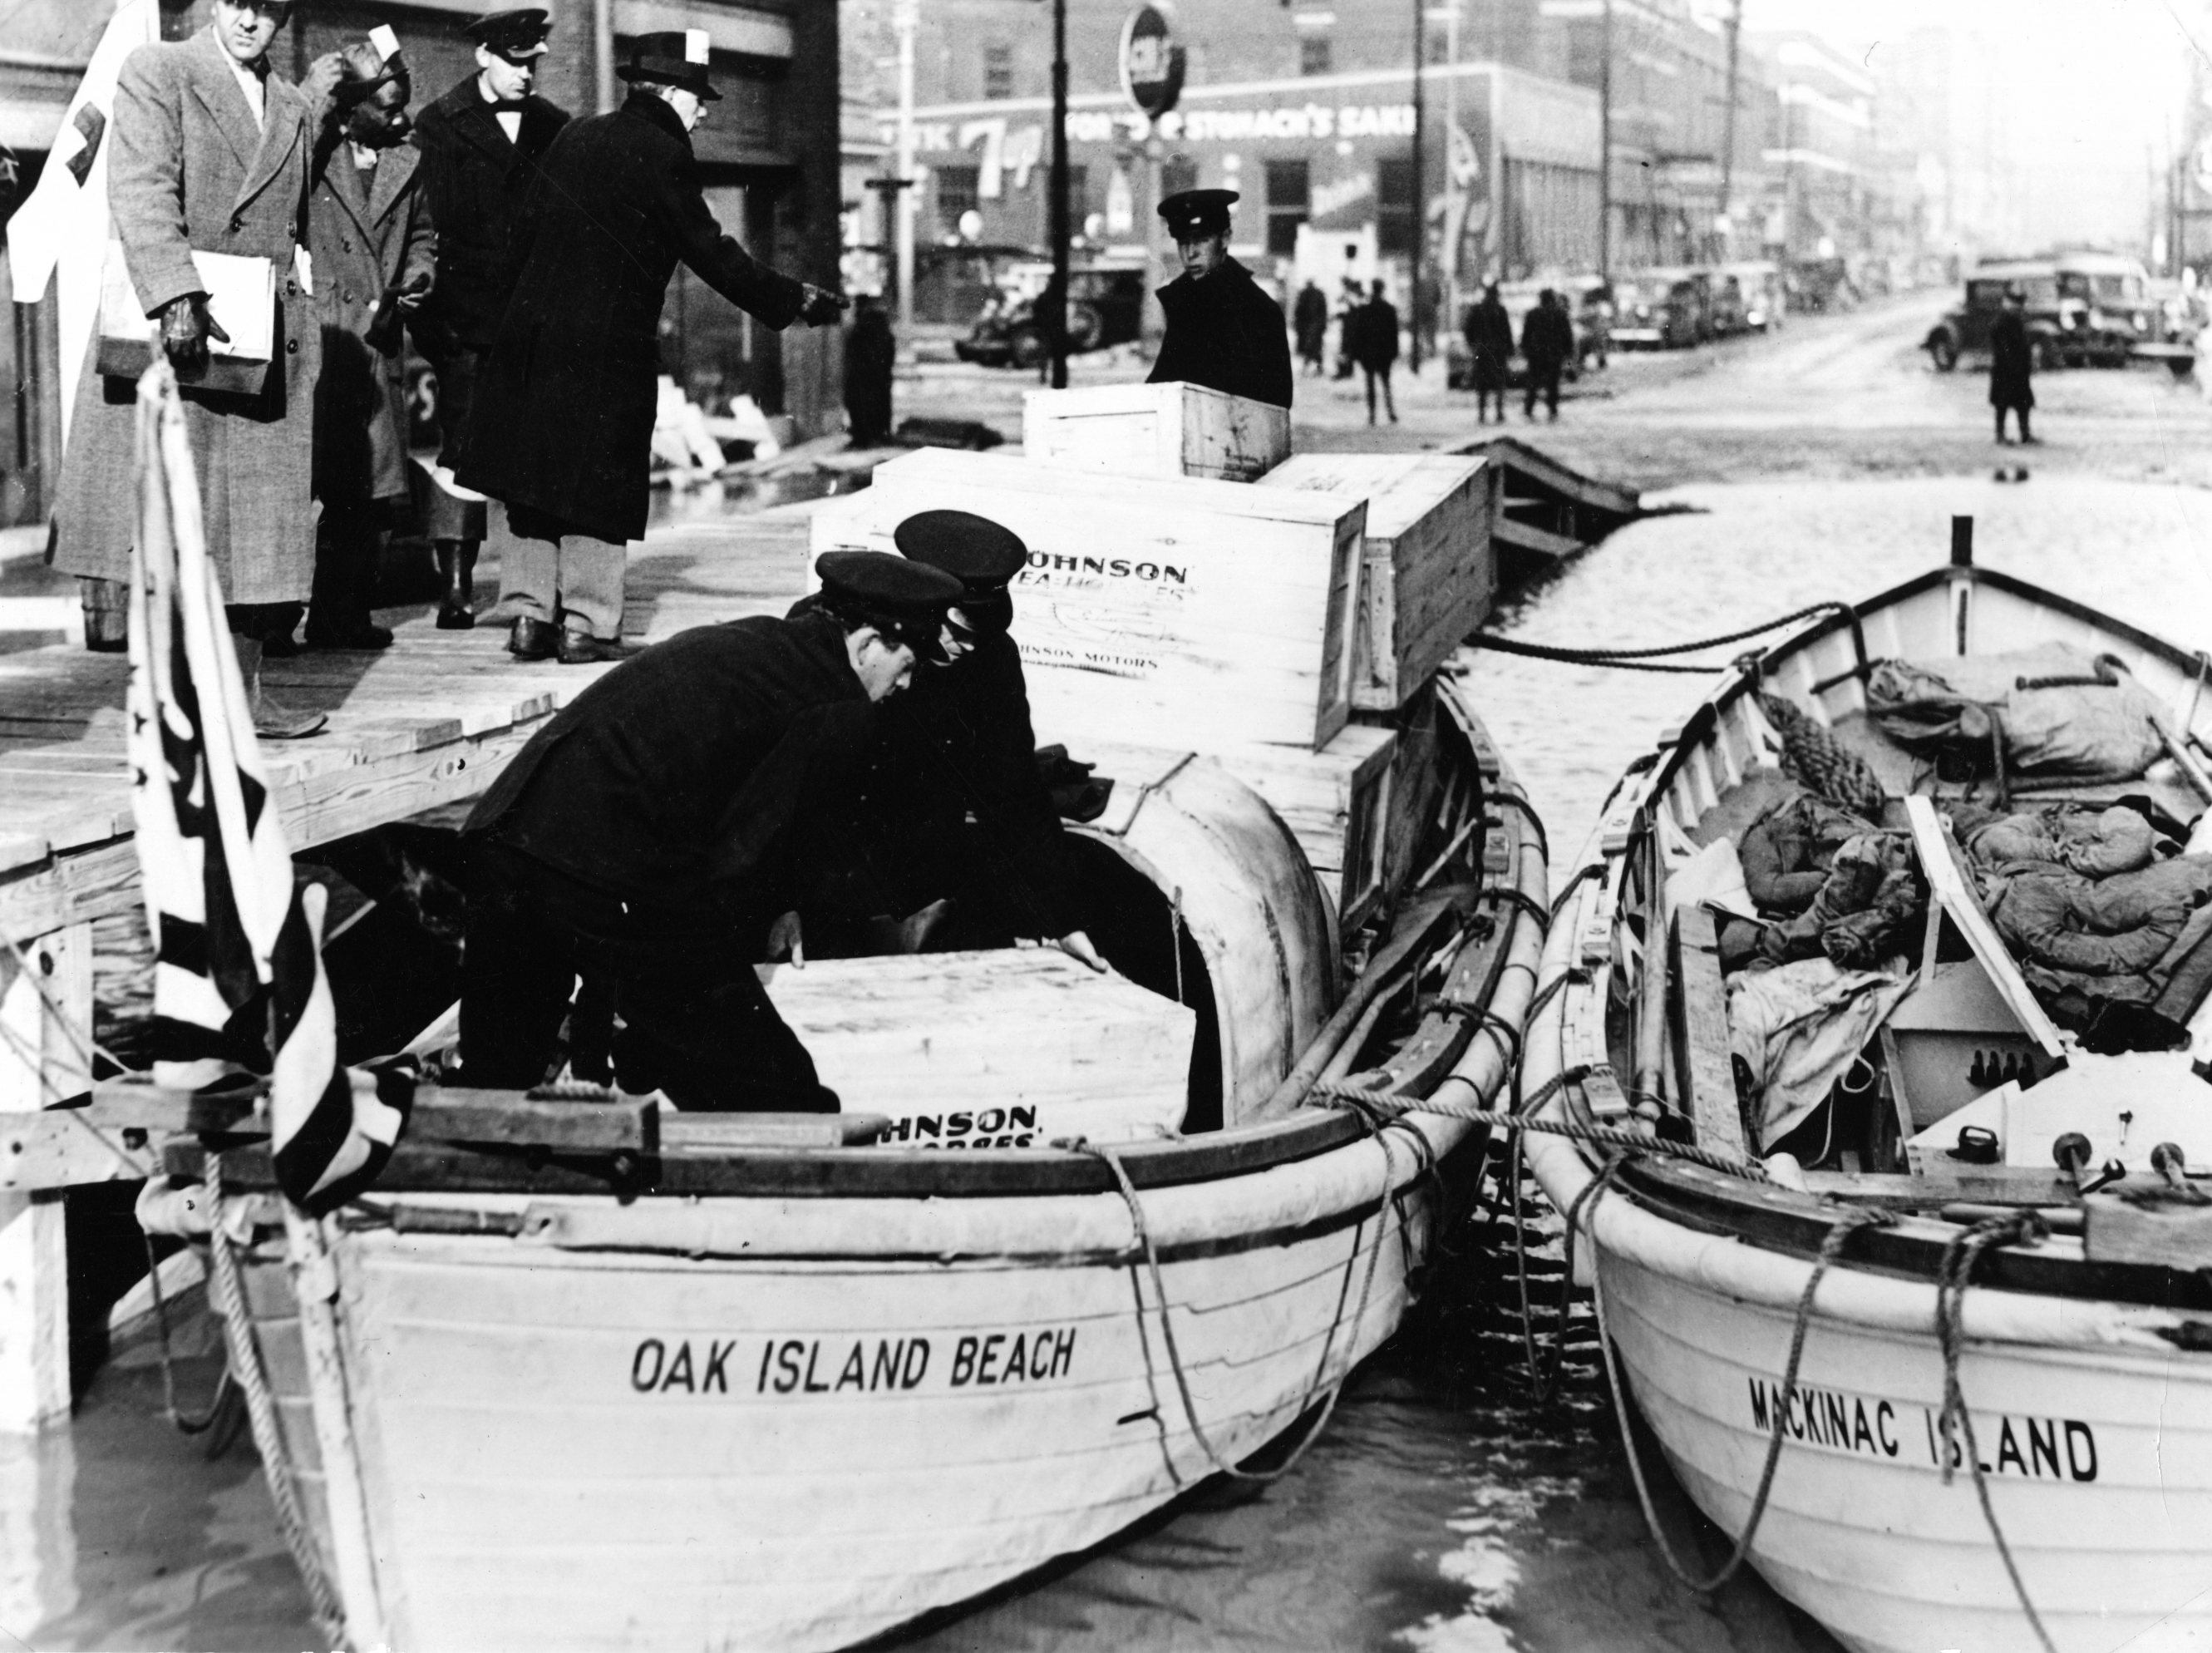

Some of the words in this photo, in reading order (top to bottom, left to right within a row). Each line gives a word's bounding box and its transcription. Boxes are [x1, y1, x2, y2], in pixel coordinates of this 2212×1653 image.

[1185, 103, 1332, 140] STOMACH'S
[1027, 550, 1186, 585] OHNSON
[1020, 644, 1073, 658] HNSON
[1085, 653, 1158, 669] MOTORS
[880, 1104, 1036, 1143] HNSON
[631, 1338, 737, 1393] OAK
[757, 1338, 930, 1393] ISLAND
[950, 1327, 1076, 1387] BEACH
[1748, 1377, 1899, 1457] MACKINAC
[1925, 1408, 2098, 1483] ISAND
